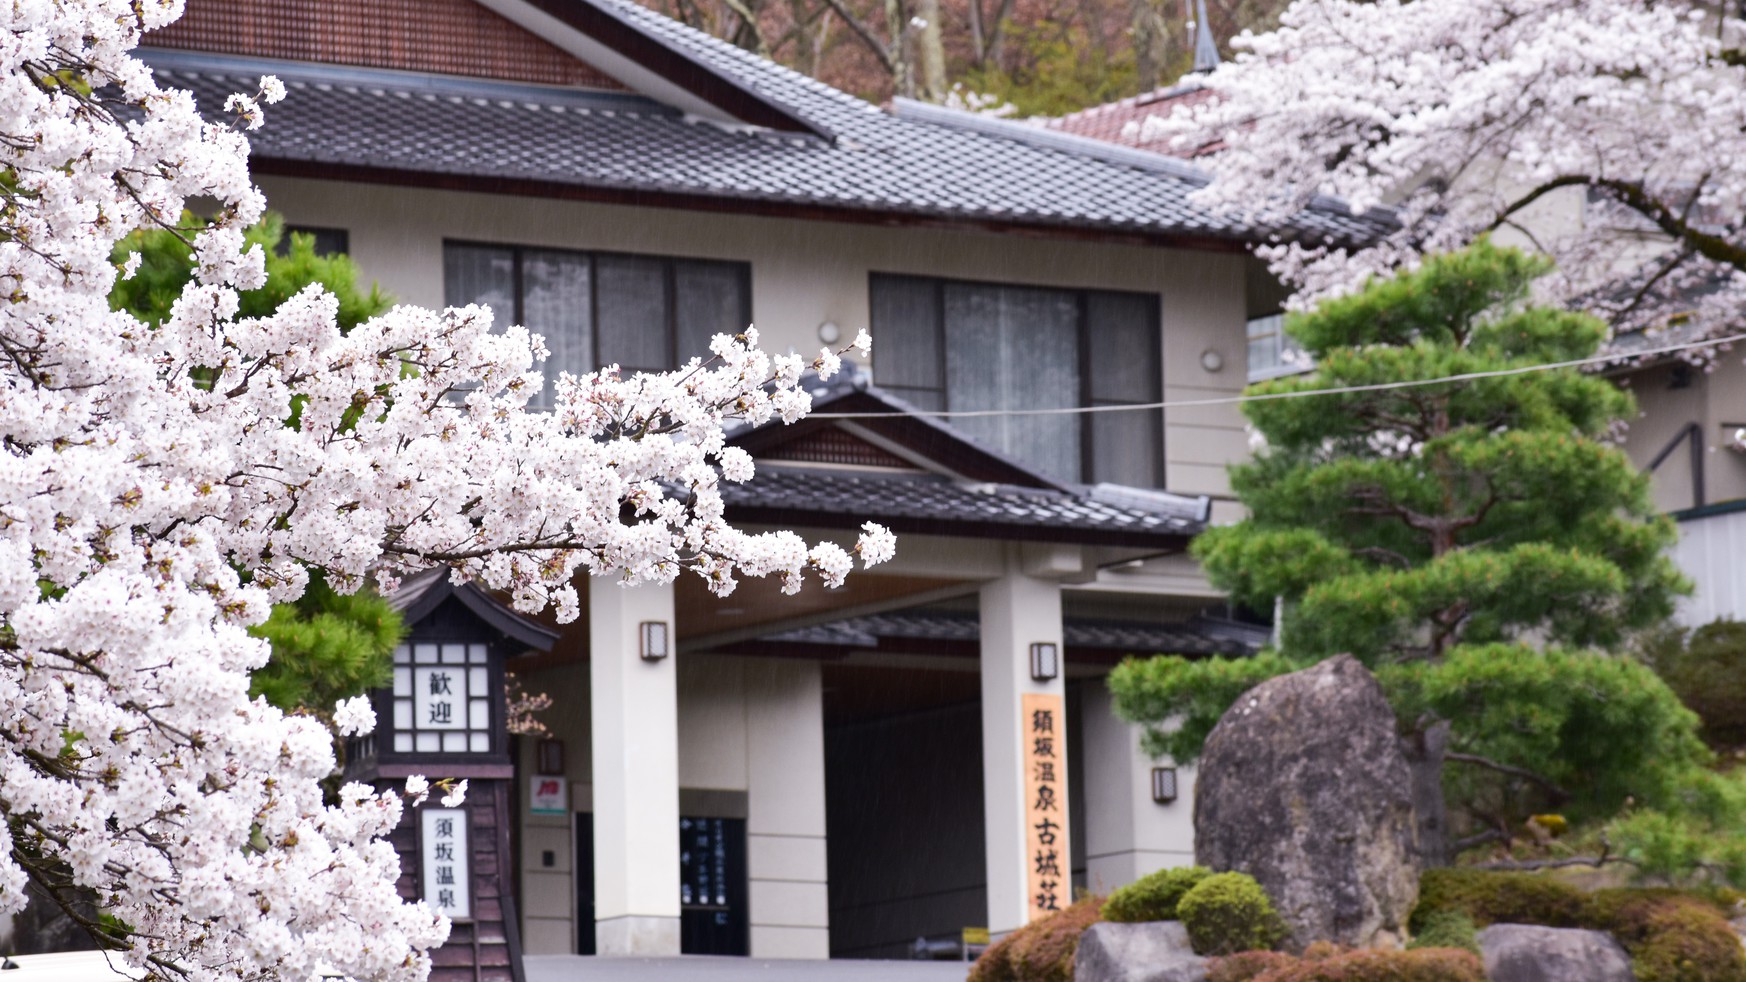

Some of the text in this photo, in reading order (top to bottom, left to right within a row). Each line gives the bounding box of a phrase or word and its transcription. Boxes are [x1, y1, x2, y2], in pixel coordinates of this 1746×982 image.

[428, 671, 453, 725] 歓迎
[1032, 708, 1062, 912] 須坂温泉古城荘
[434, 816, 457, 910] 須坂温泉
